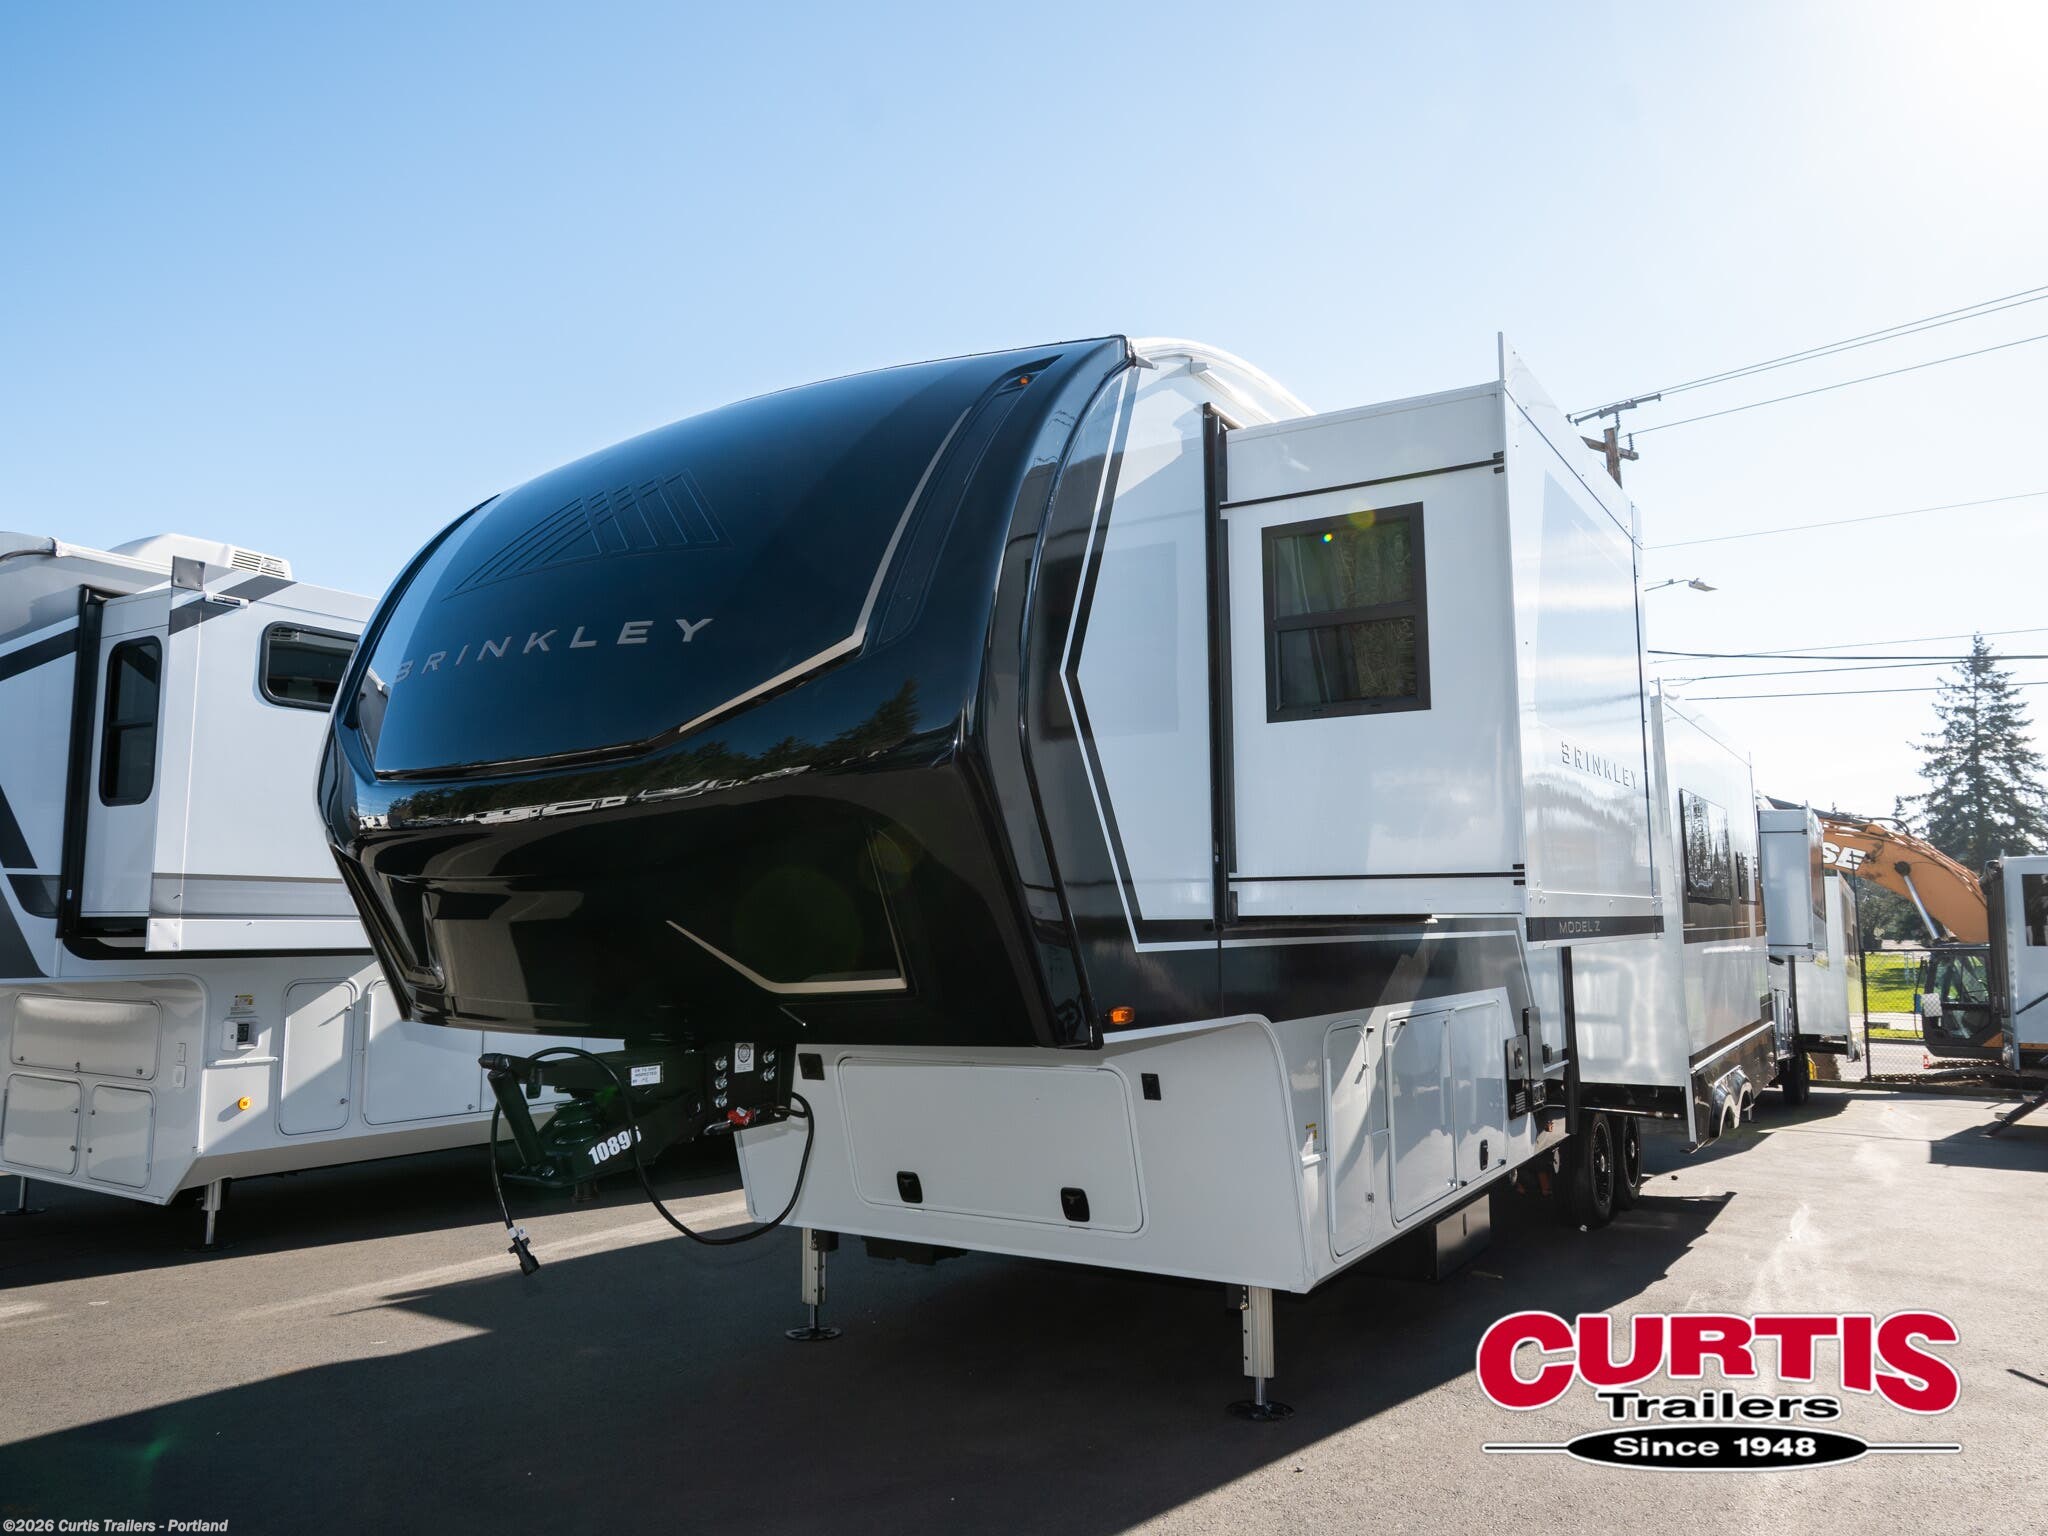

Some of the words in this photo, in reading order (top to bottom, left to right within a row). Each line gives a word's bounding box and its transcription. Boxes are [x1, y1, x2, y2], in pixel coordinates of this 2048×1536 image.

[395, 618, 713, 682] BRINKLEY
[1561, 740, 1637, 790] BRINKLEY
[1822, 842, 1867, 870] SE
[1559, 920, 1593, 934] MODEL
[1594, 920, 1601, 932] Z
